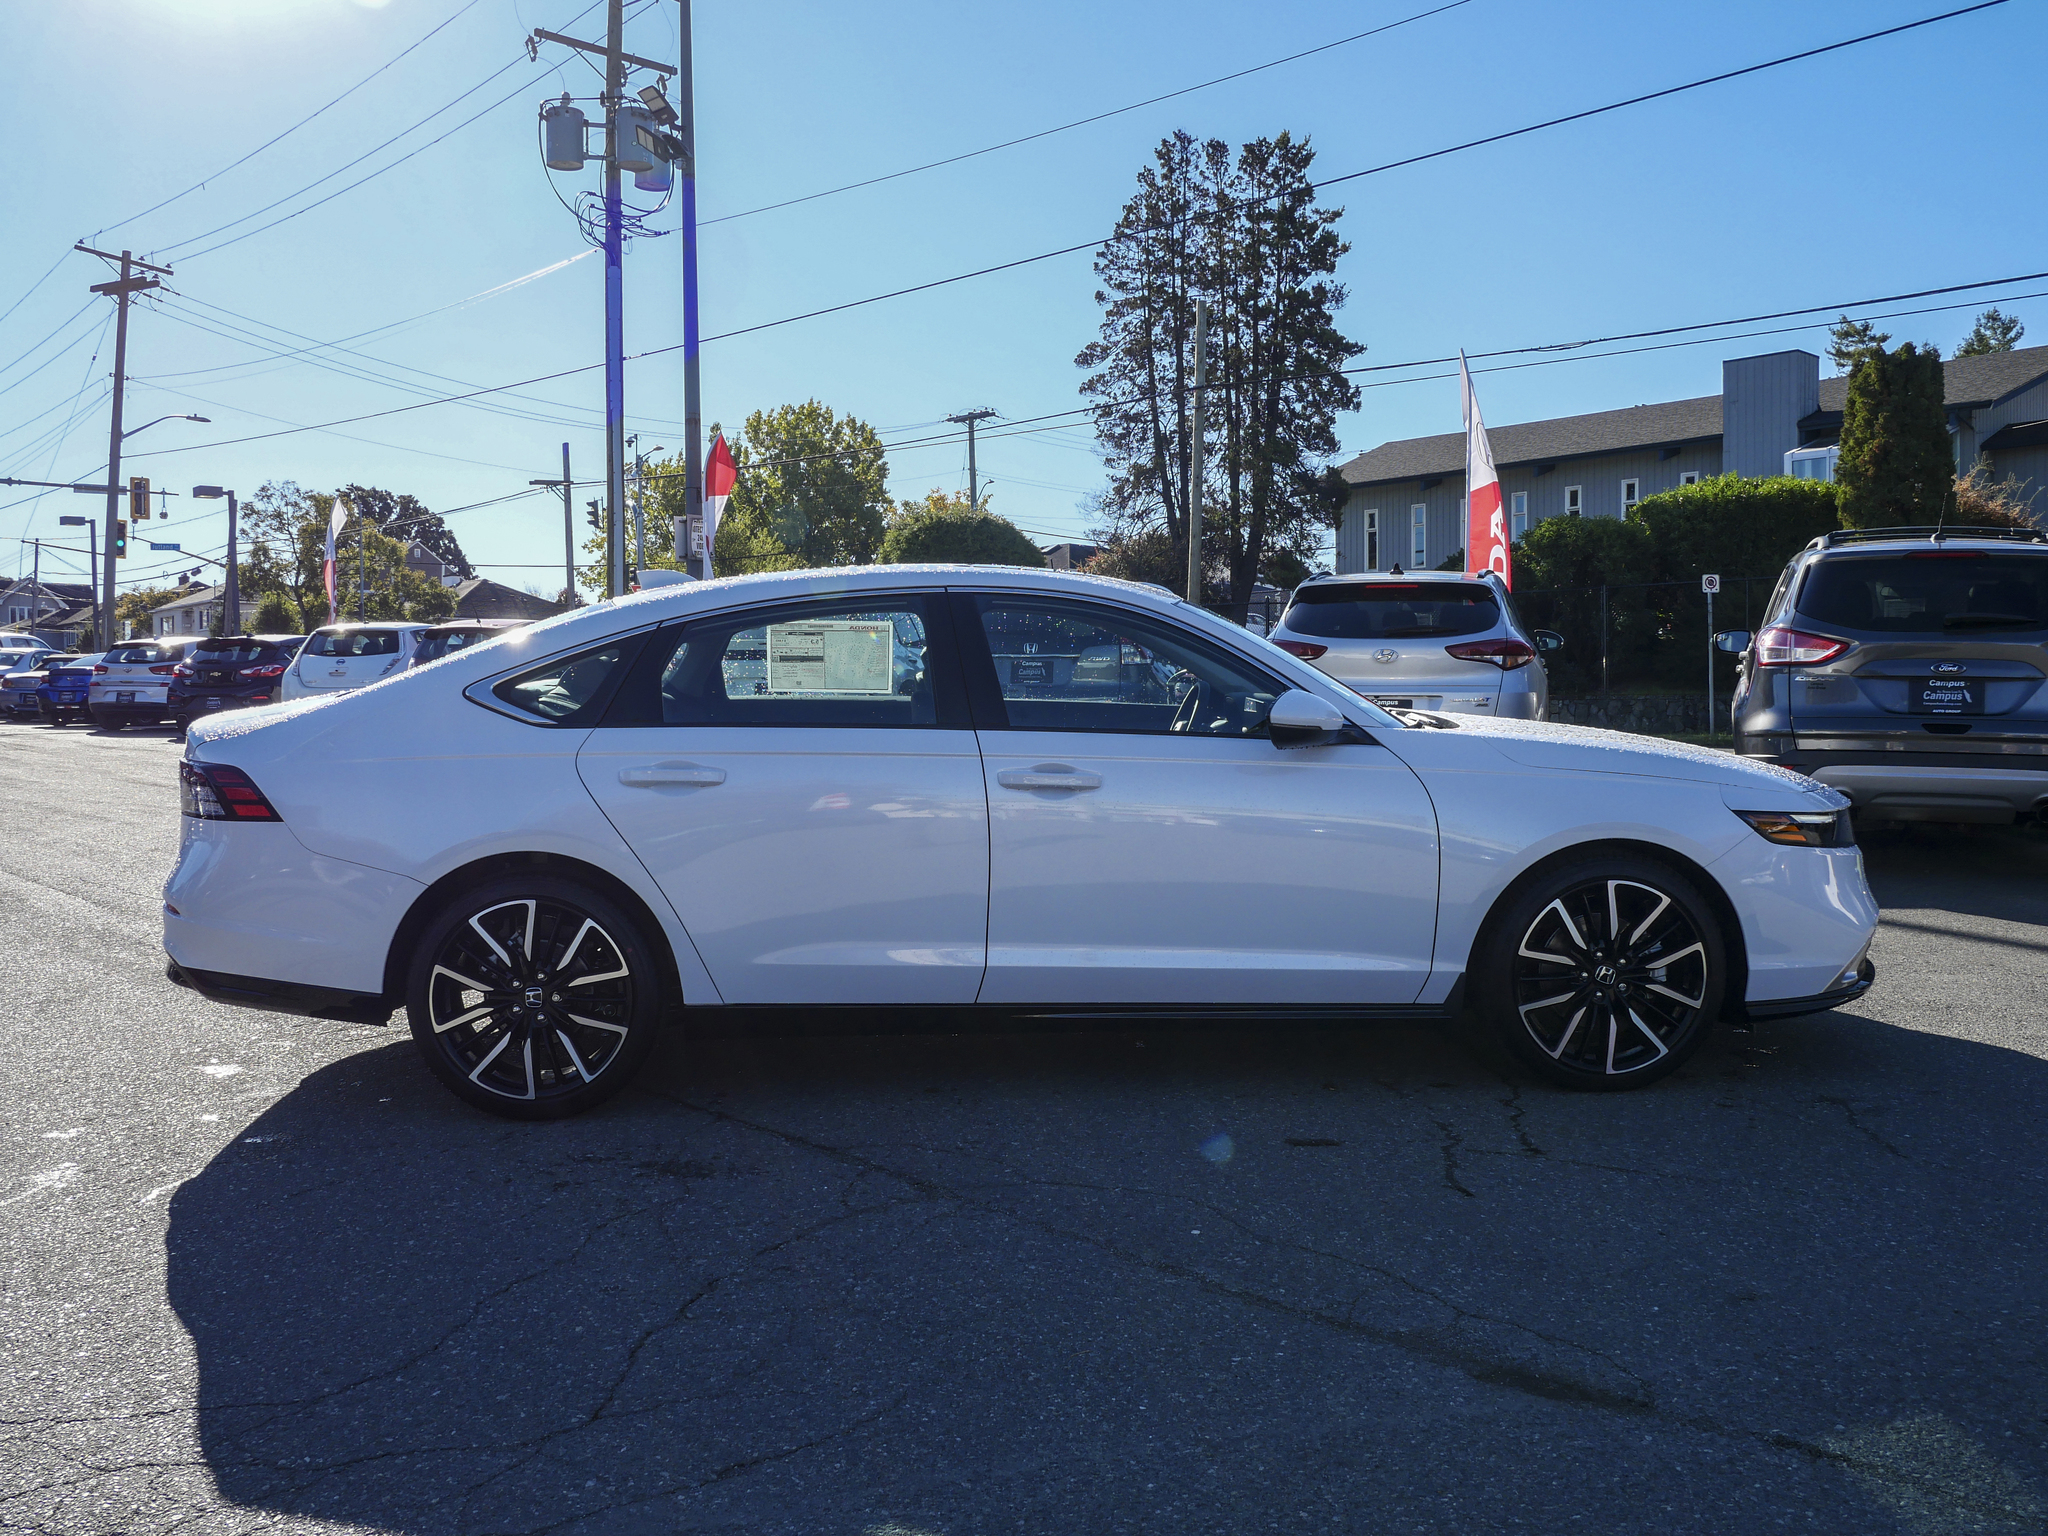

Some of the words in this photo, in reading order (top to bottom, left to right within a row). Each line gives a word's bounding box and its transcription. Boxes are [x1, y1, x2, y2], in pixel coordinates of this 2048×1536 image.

[1938, 663, 1959, 672] Ford
[1929, 680, 1966, 688] Campus
[1923, 690, 1962, 702] Campus
